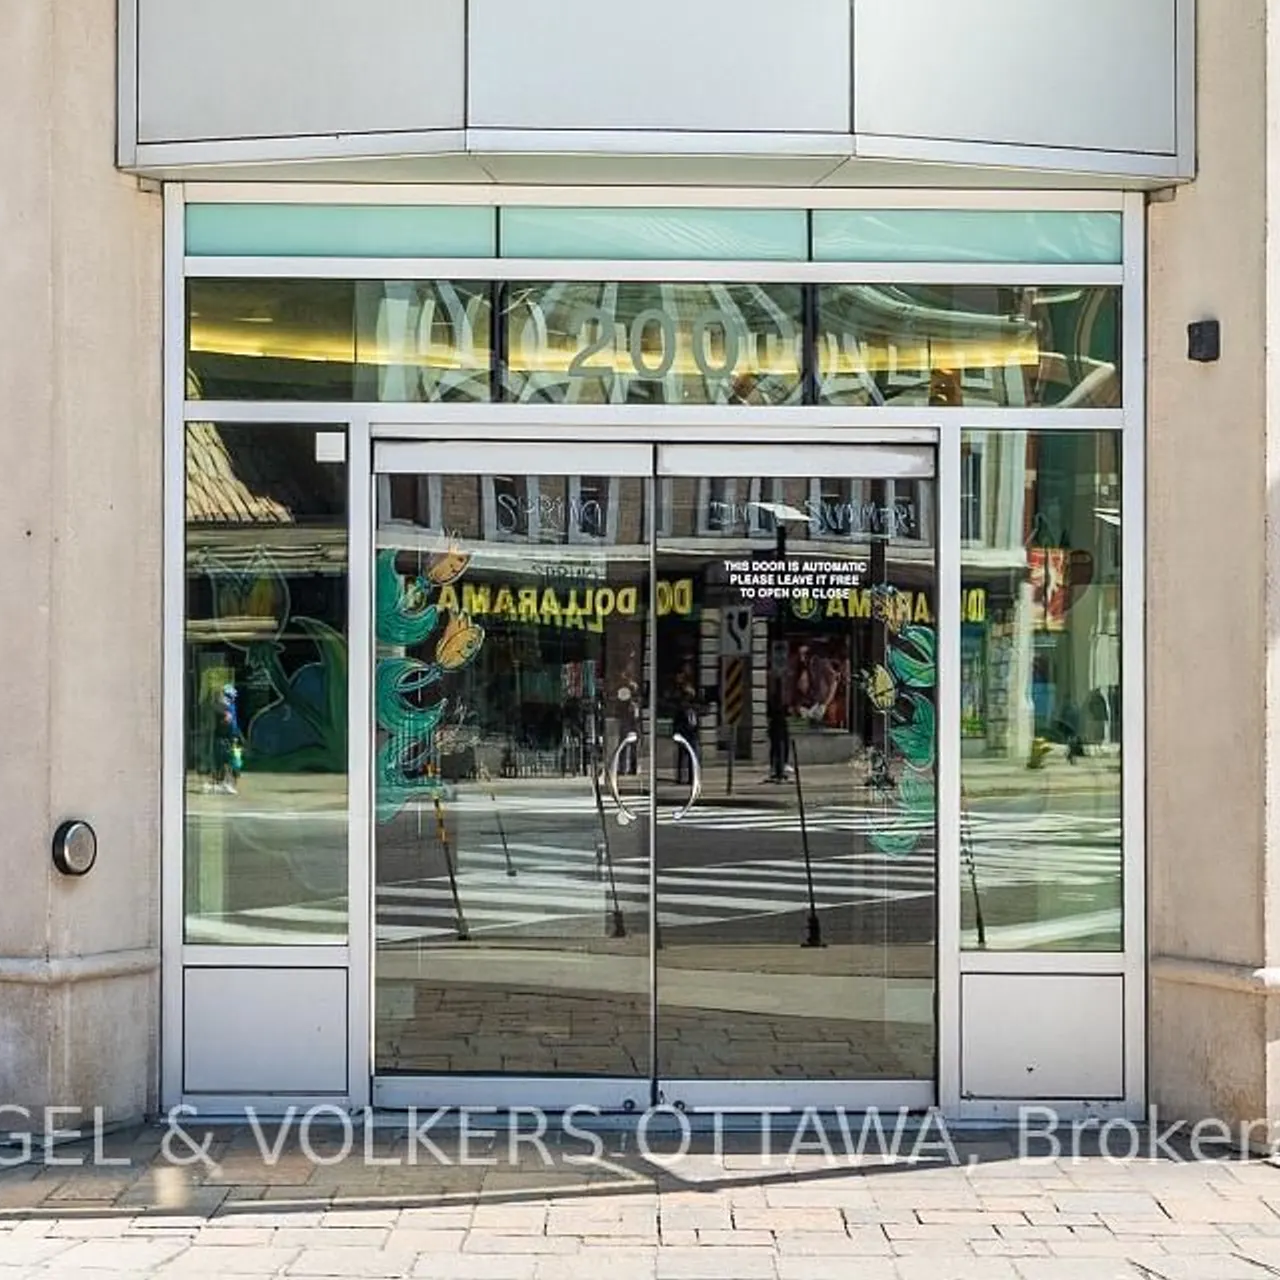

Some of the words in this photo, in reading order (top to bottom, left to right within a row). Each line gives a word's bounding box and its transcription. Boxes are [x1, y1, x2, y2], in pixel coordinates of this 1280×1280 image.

[569, 308, 740, 379] 200
[723, 560, 749, 572] THIS
[752, 560, 785, 572] DOOR
[788, 561, 799, 572] IS
[802, 561, 868, 573] AUTOMATIC
[730, 574, 776, 586] PLEASE
[778, 574, 814, 586] LEAVE
[816, 574, 827, 585] IT
[829, 574, 860, 586] FREE
[740, 588, 756, 598] TO
[758, 588, 790, 598] OPEN
[792, 588, 810, 598] OR
[812, 588, 850, 599] CLOSE
